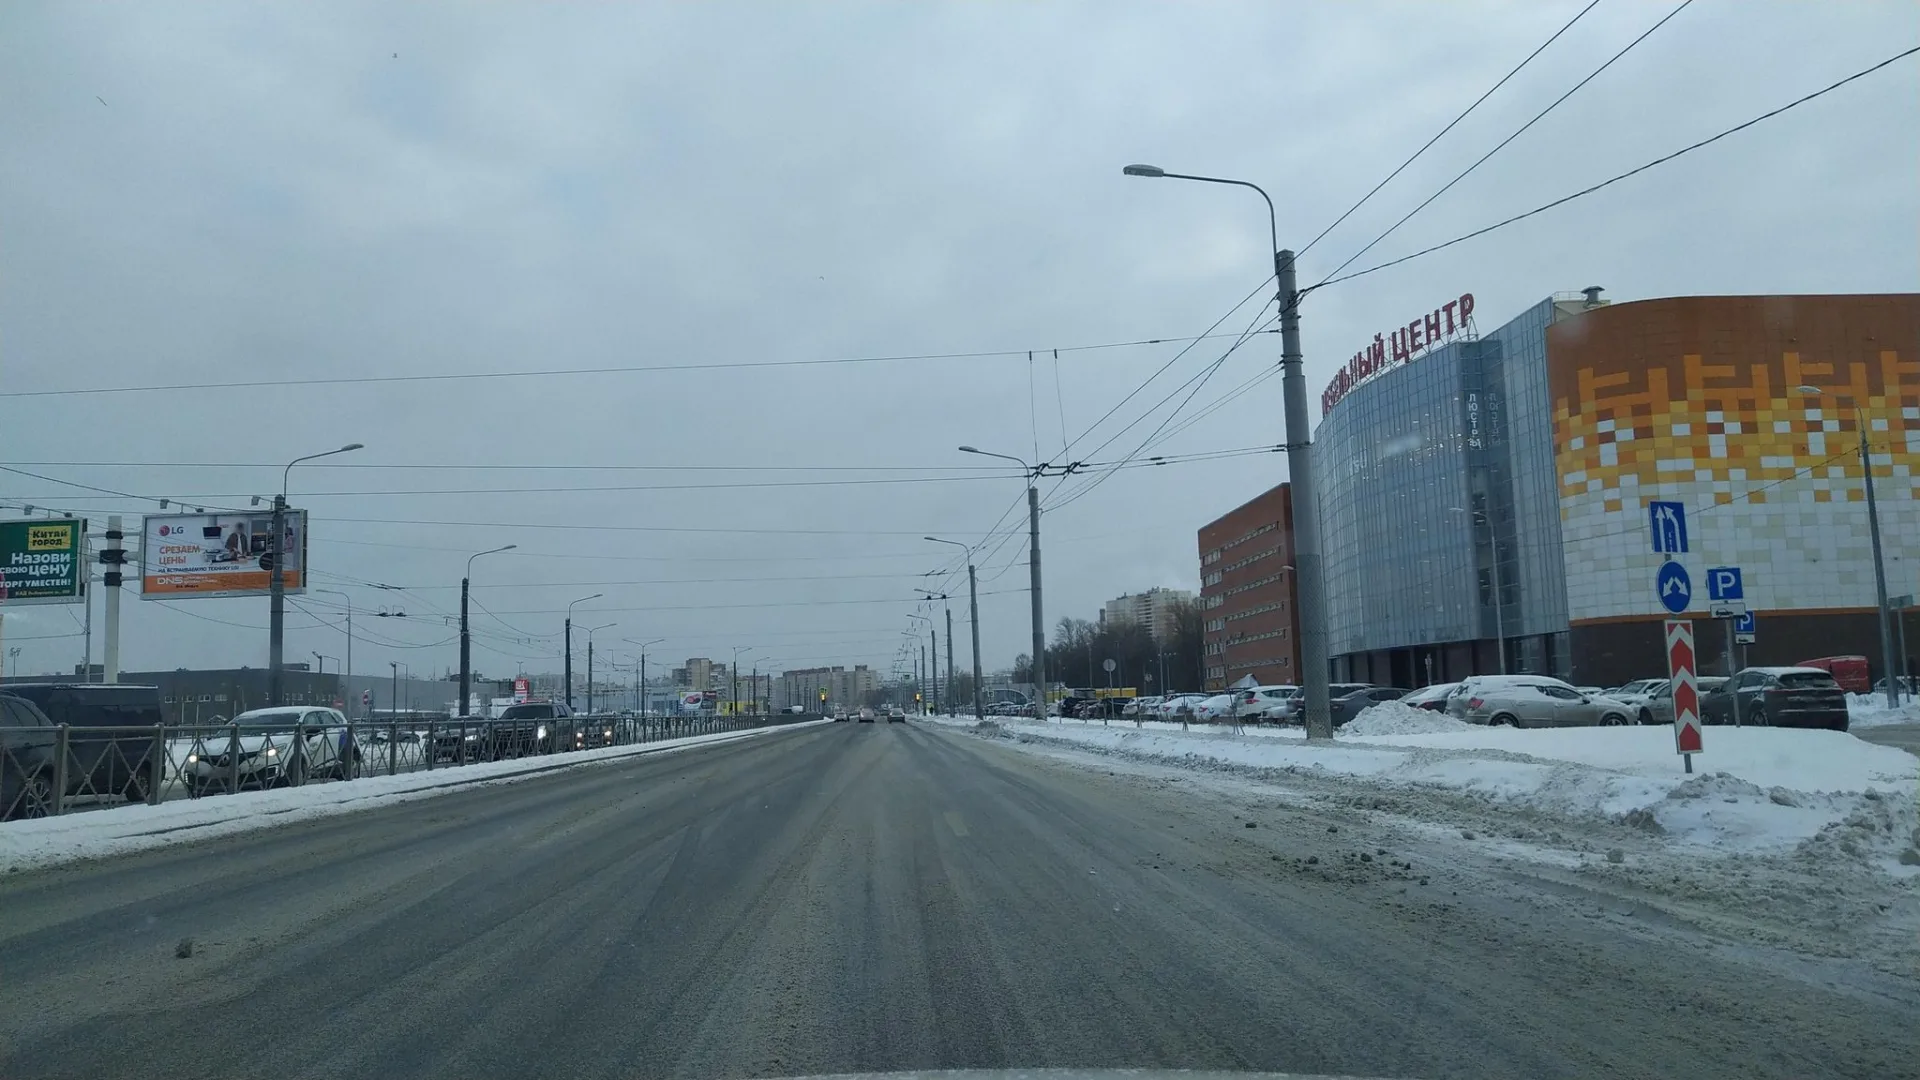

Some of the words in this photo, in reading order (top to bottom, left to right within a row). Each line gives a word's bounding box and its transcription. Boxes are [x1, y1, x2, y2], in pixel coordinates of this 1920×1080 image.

[1391, 293, 1474, 364] ЦЕНТР
[1468, 393, 1481, 448] ЛЮСТРЫ
[171, 526, 184, 534] LG
[159, 545, 200, 554] СРЕЗАЕМ
[11, 552, 71, 565] Назови
[159, 556, 186, 566] ЦЕНЫ
[29, 563, 71, 577] цену
[25, 578, 71, 587] УМЕСТЕН!
[157, 576, 183, 585] DNS
[1717, 571, 1736, 597] P
[1740, 612, 1750, 630] P
